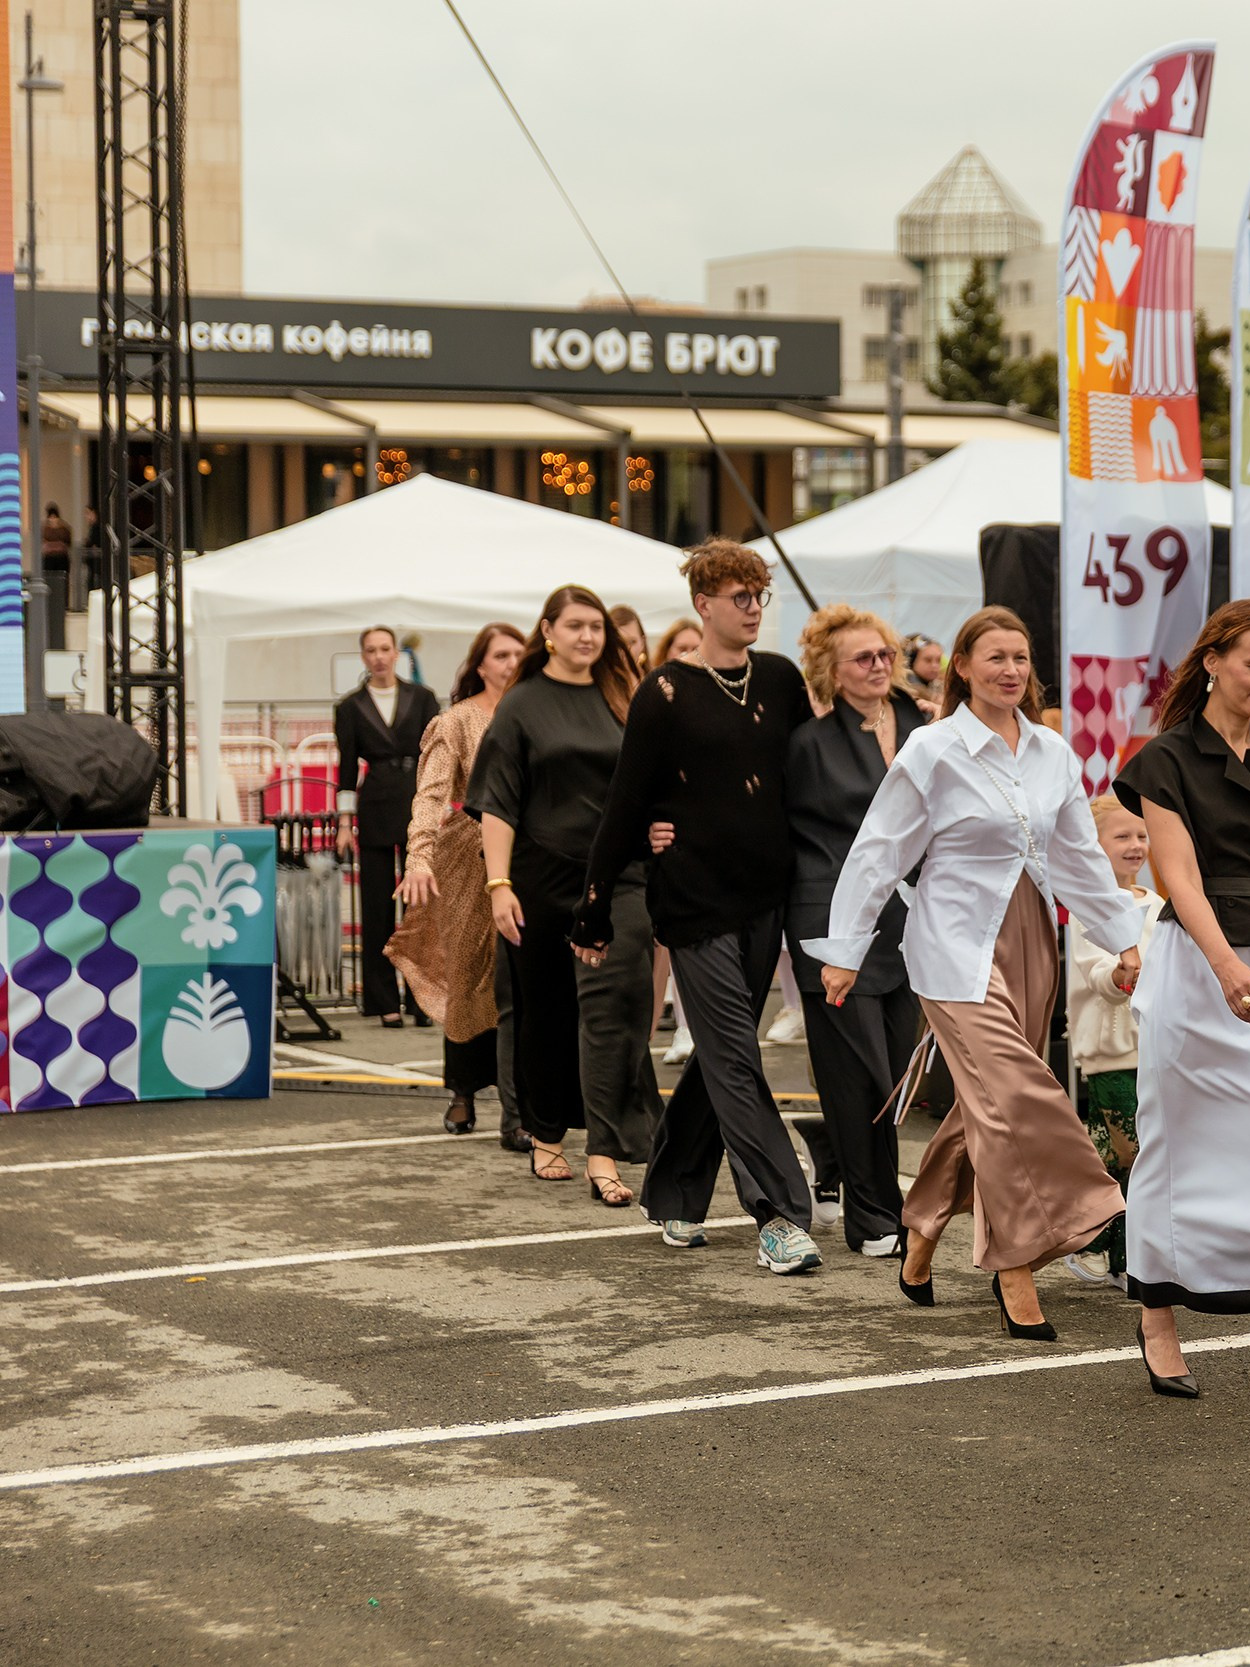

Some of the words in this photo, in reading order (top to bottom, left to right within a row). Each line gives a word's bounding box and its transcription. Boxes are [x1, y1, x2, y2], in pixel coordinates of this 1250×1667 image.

[81, 317, 274, 354] гская
[282, 319, 432, 362] кофейня
[530, 327, 653, 375] КОФЕ
[665, 332, 780, 377] БРЮТ
[1082, 525, 1189, 606] 439
